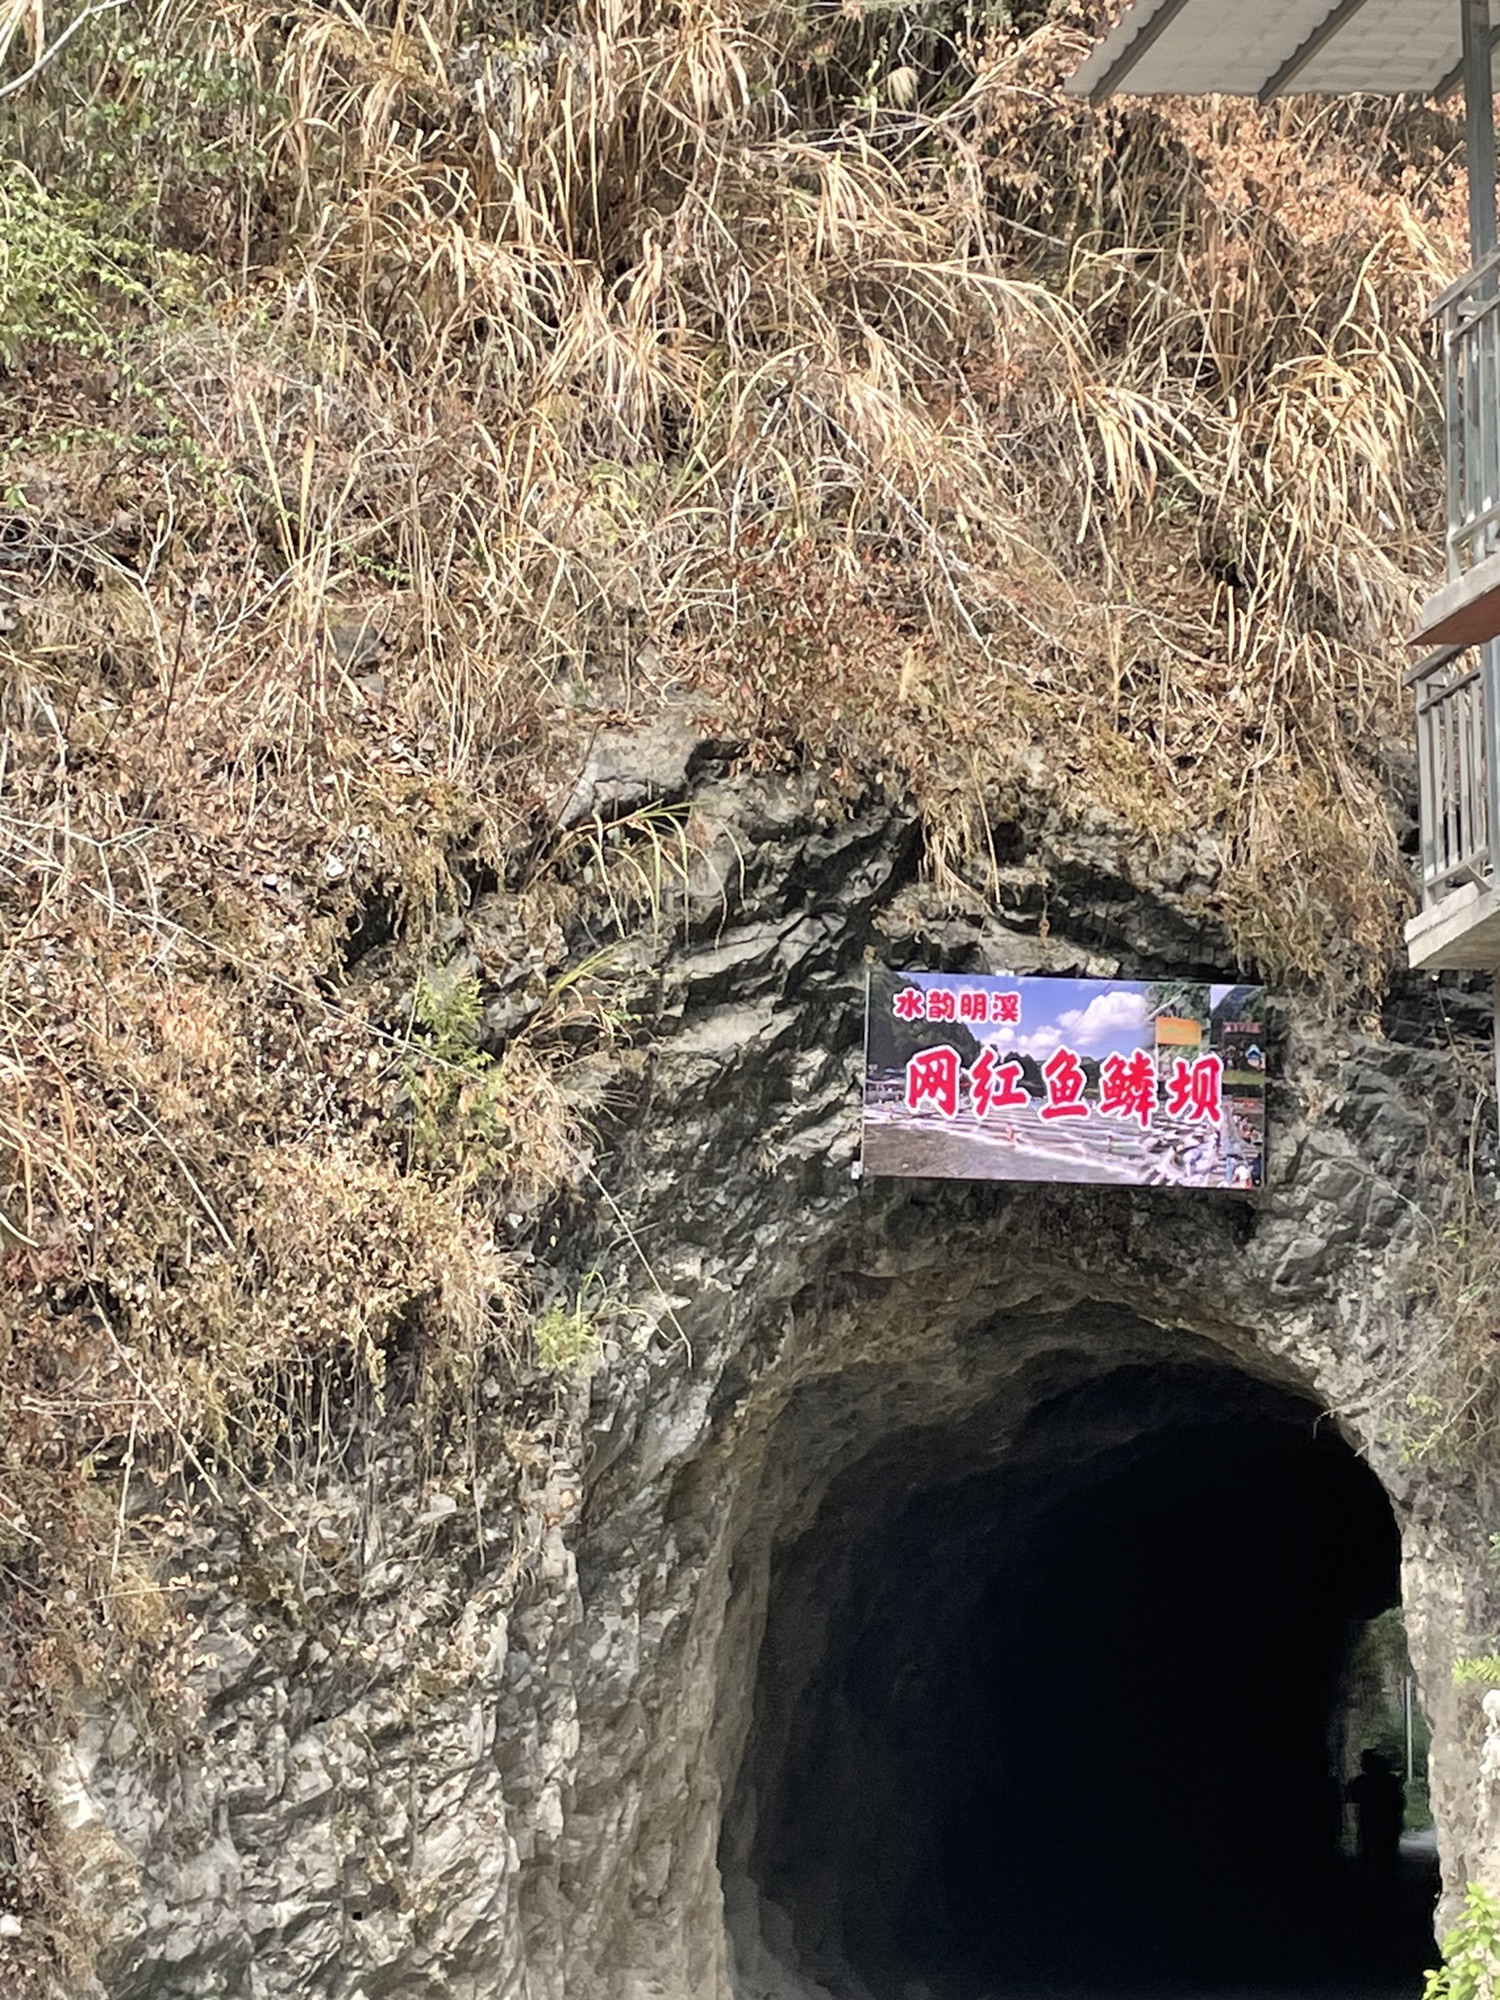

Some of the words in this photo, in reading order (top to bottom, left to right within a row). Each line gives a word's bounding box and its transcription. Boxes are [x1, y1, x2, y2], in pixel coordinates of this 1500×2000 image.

[894, 988, 1021, 1023] 水韵明溪
[906, 1045, 1224, 1127] 网红鱼鳞坝
